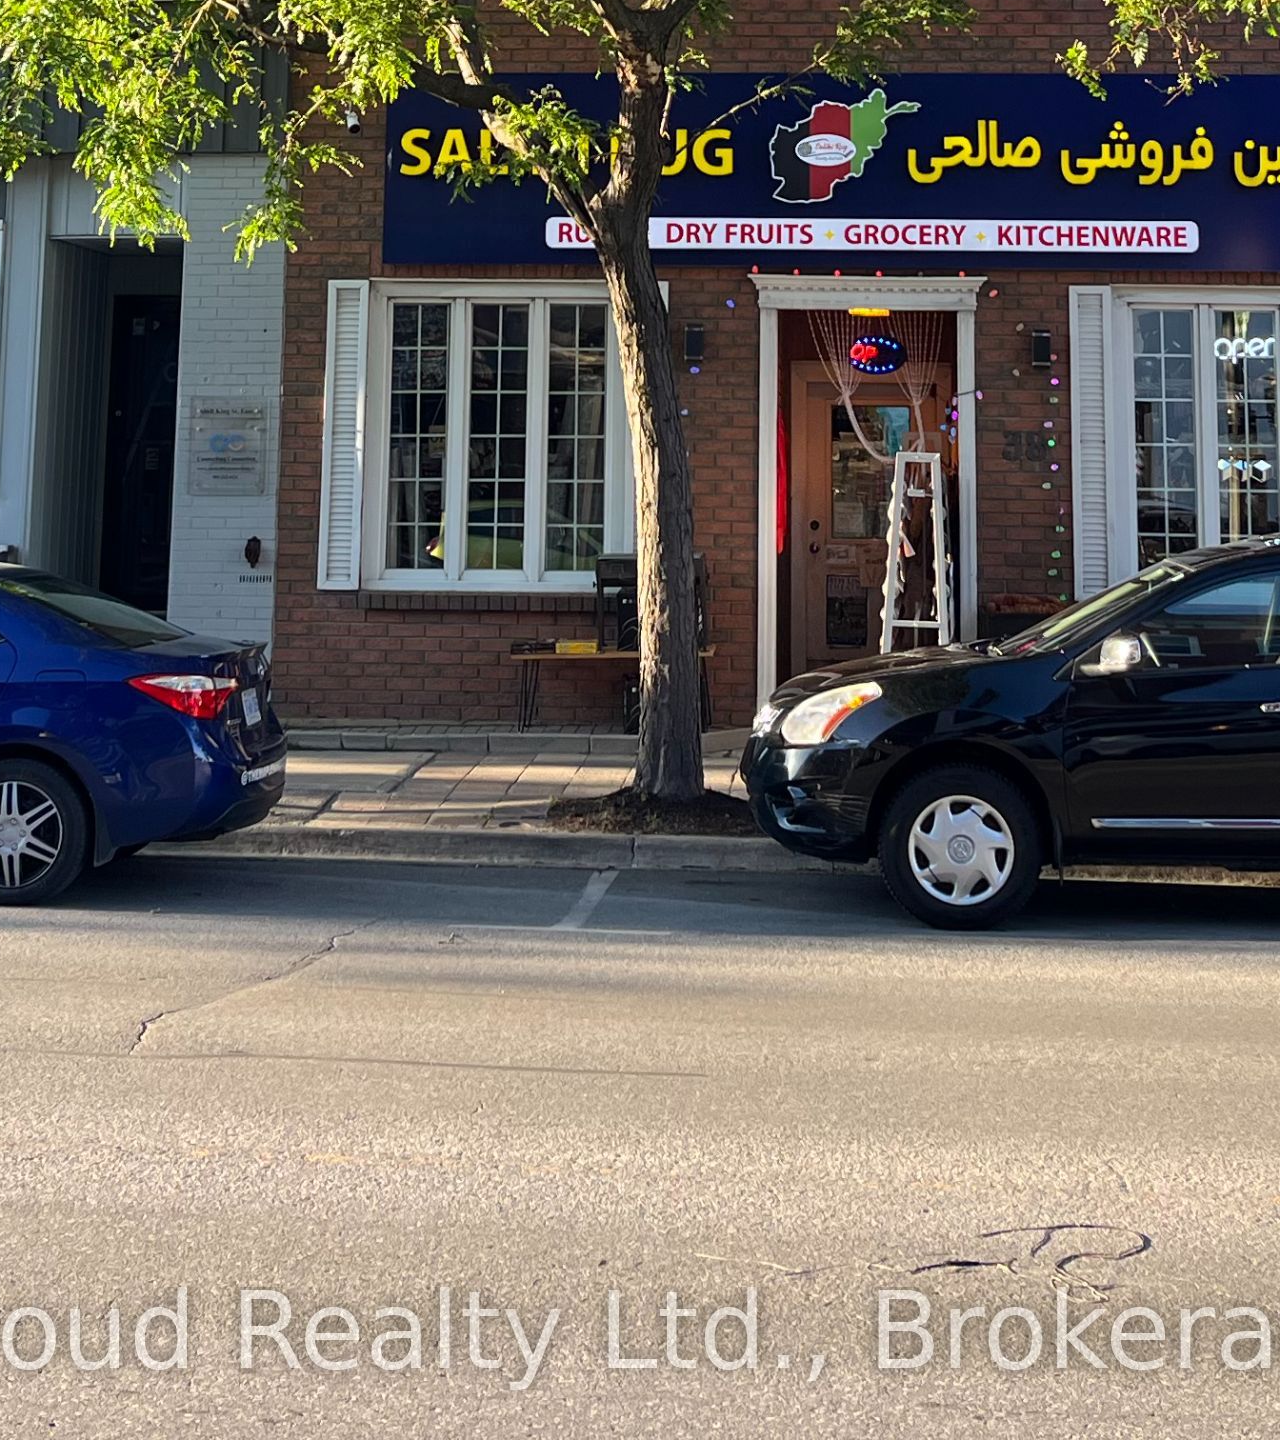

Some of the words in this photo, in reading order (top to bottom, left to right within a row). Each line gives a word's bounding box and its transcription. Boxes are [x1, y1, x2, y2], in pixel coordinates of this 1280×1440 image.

[666, 223, 718, 244] DRY
[725, 223, 814, 245] FRUITS
[844, 223, 967, 246] GROCERY
[997, 224, 1188, 248] KITCHENWARE
